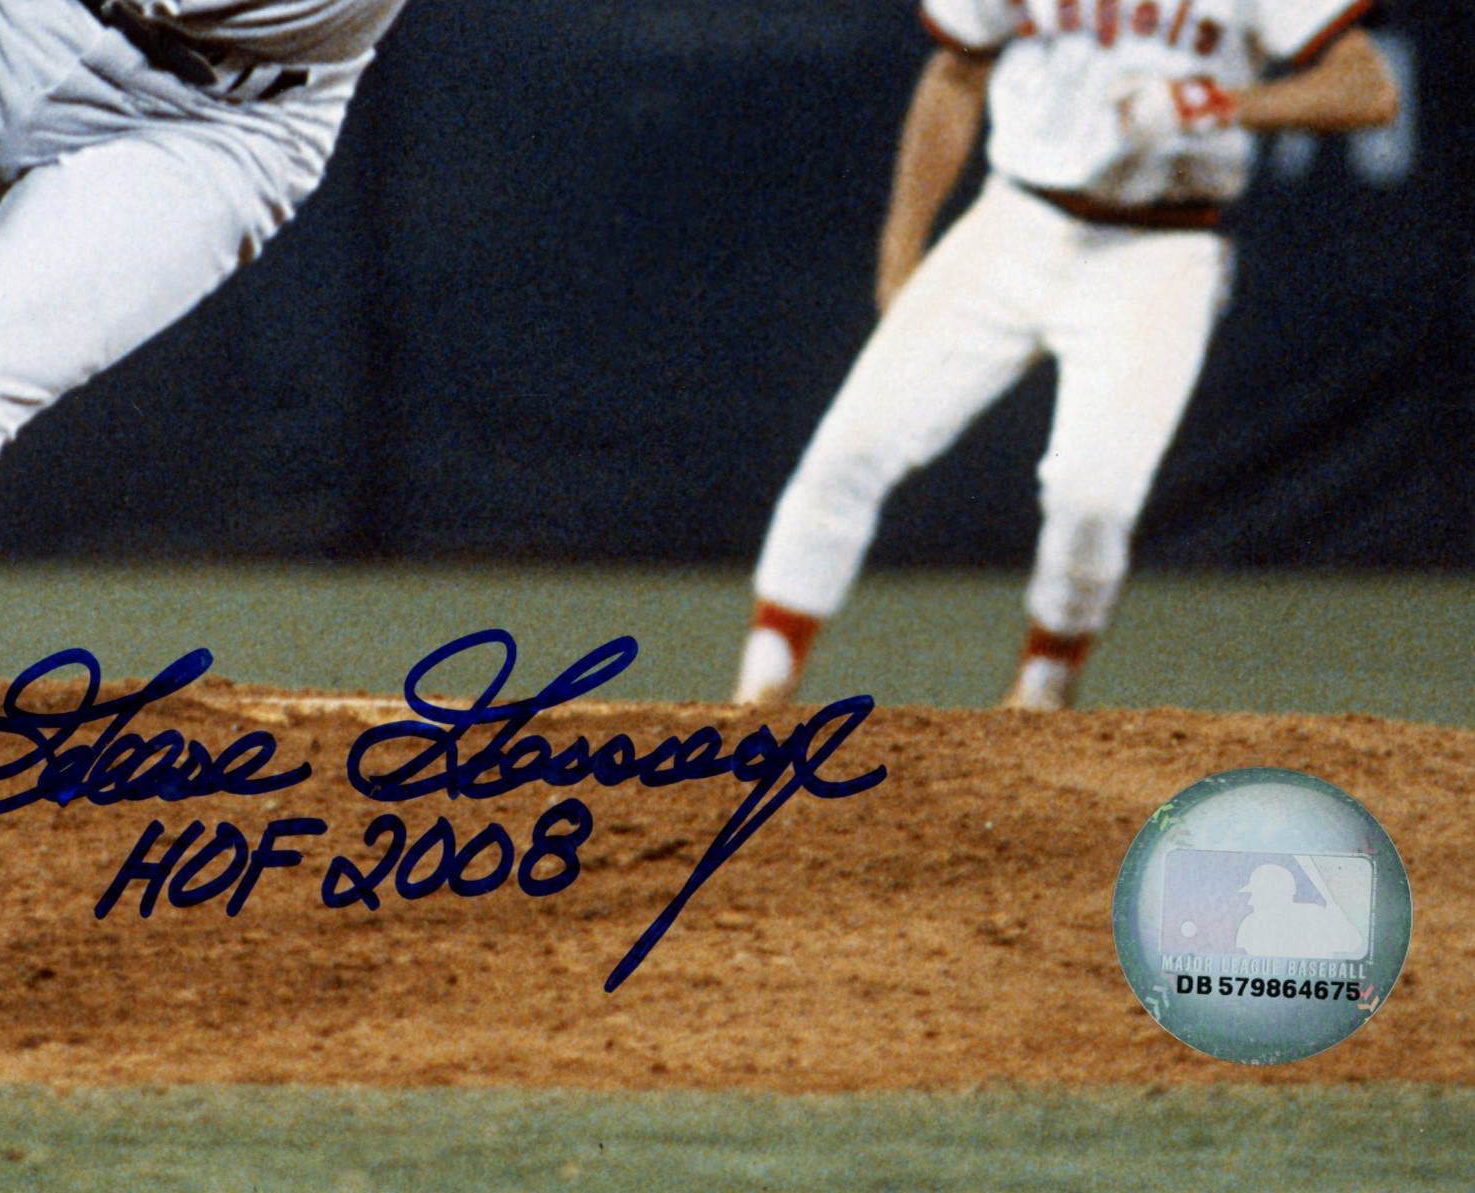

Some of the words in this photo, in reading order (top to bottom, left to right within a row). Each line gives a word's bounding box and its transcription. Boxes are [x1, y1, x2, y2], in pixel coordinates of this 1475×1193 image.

[94, 817, 327, 919] HOF
[323, 799, 593, 911] 2008
[1161, 955, 1213, 973] MAJOR
[1221, 957, 1278, 975] LEAGUE
[1177, 975, 1212, 995] DB
[1218, 976, 1360, 1001] 579864675
